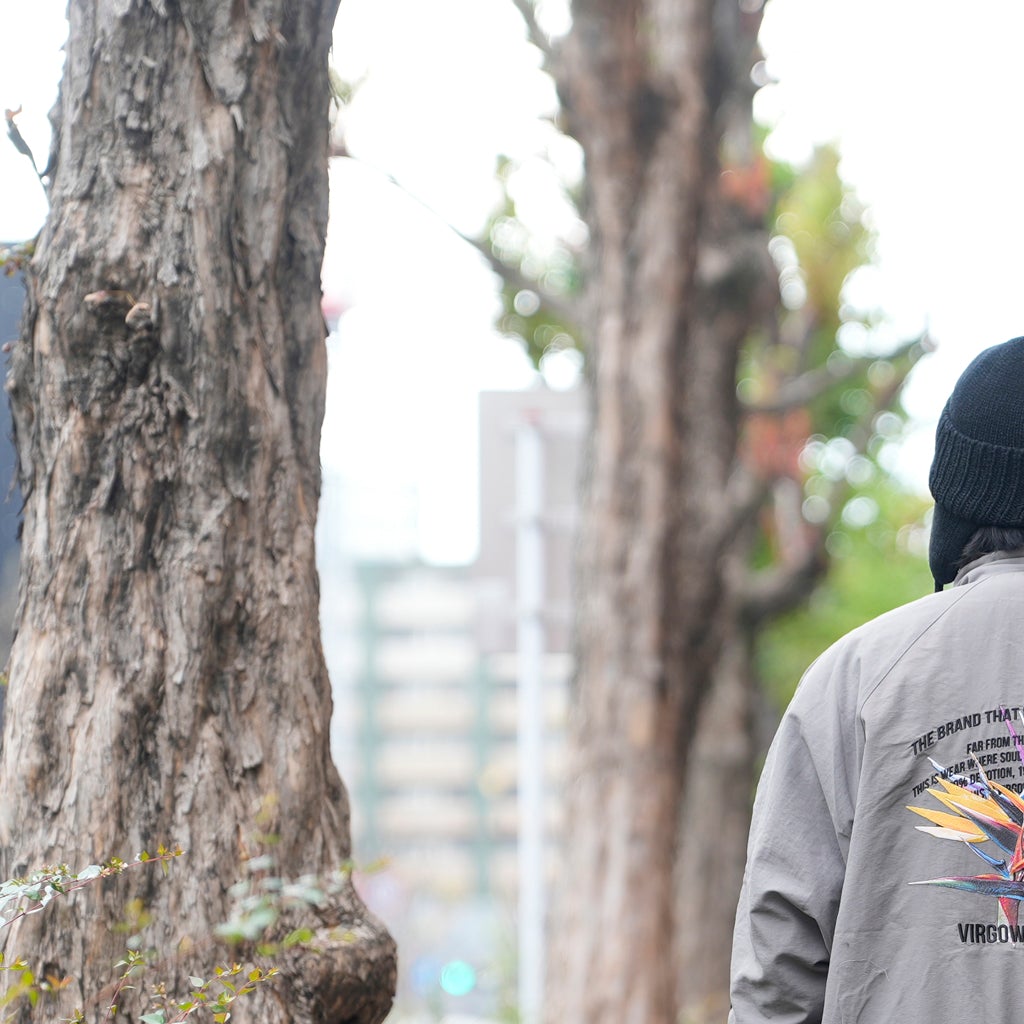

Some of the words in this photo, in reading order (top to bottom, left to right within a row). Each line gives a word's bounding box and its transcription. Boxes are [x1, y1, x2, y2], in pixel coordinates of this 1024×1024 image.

[911, 730, 935, 756] THE
[937, 713, 981, 740] BRAND
[984, 708, 1020, 724] THAT
[967, 741, 984, 755] FAR
[986, 736, 1010, 750] FROM
[912, 778, 930, 798] THIS
[931, 773, 939, 786] IS
[941, 761, 965, 780] WEAR
[1000, 750, 1022, 763] SOUL
[970, 766, 1015, 785] DEOTION,
